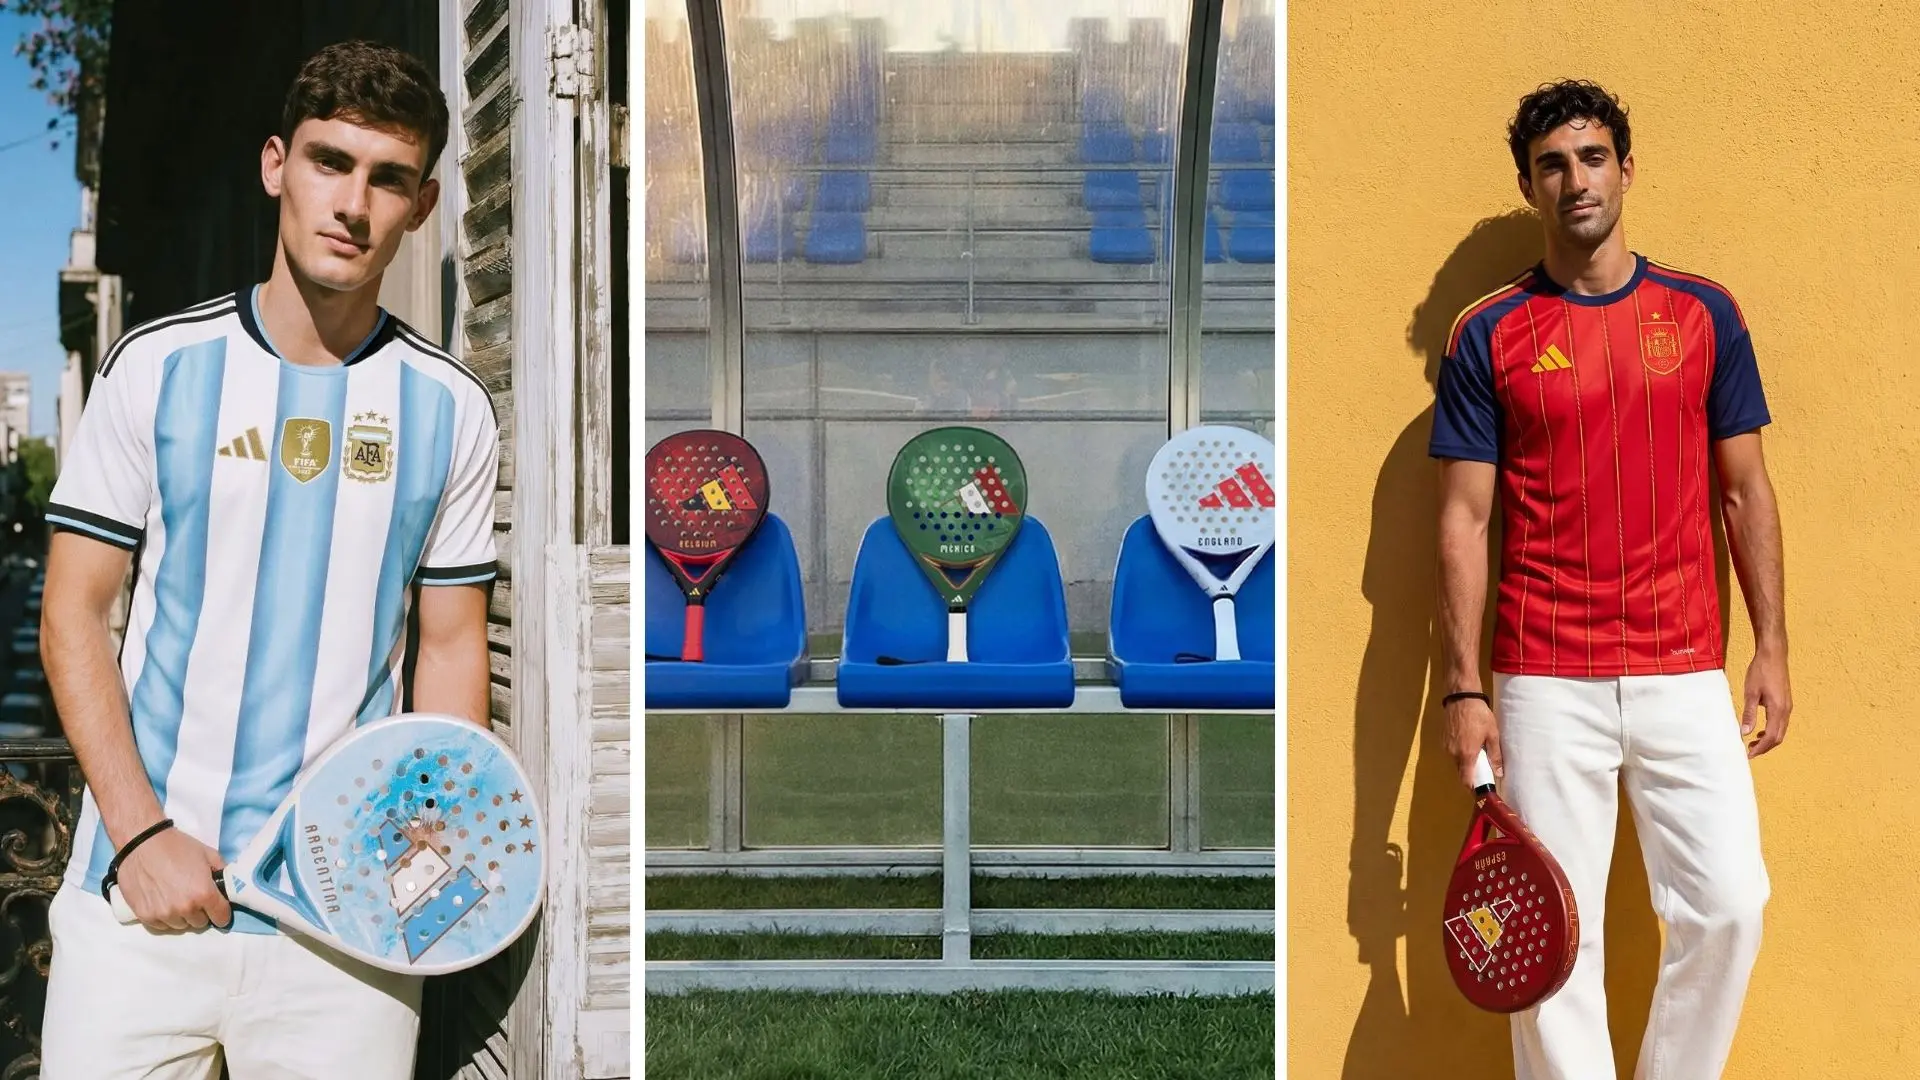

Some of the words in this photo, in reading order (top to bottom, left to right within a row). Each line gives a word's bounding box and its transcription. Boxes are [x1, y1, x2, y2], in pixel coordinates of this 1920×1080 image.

[354, 440, 382, 467] AFA
[294, 457, 316, 467] FIFA
[679, 540, 717, 548] BELGIUM
[1198, 537, 1243, 546] ENGLAND
[305, 824, 340, 913] ARGENTINA
[1475, 851, 1506, 871] ESPAÑA
